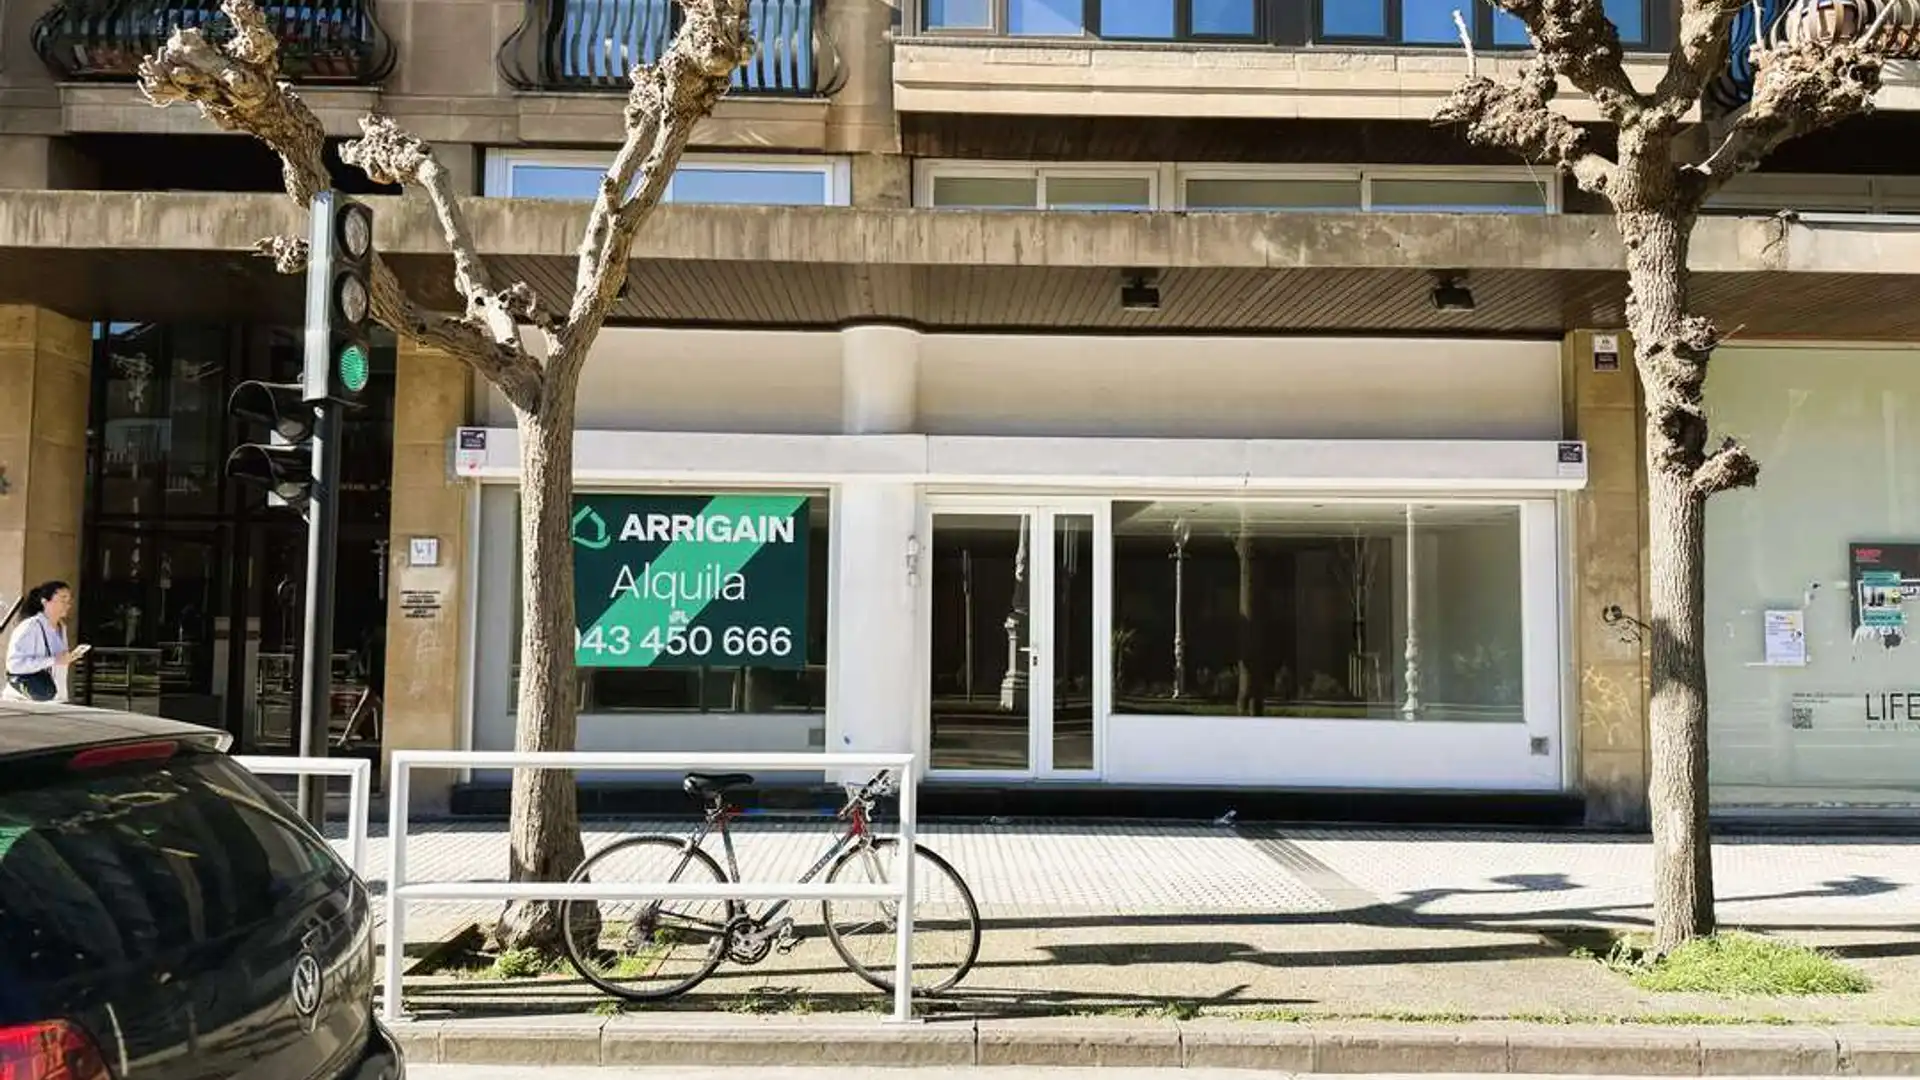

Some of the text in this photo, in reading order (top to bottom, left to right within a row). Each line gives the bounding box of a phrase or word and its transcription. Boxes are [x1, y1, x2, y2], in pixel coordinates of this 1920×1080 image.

[620, 514, 794, 543] ARRIGAIN
[610, 562, 745, 606] Alquila
[575, 626, 791, 655] 43 450 666
[1866, 693, 1920, 720] LIFE
